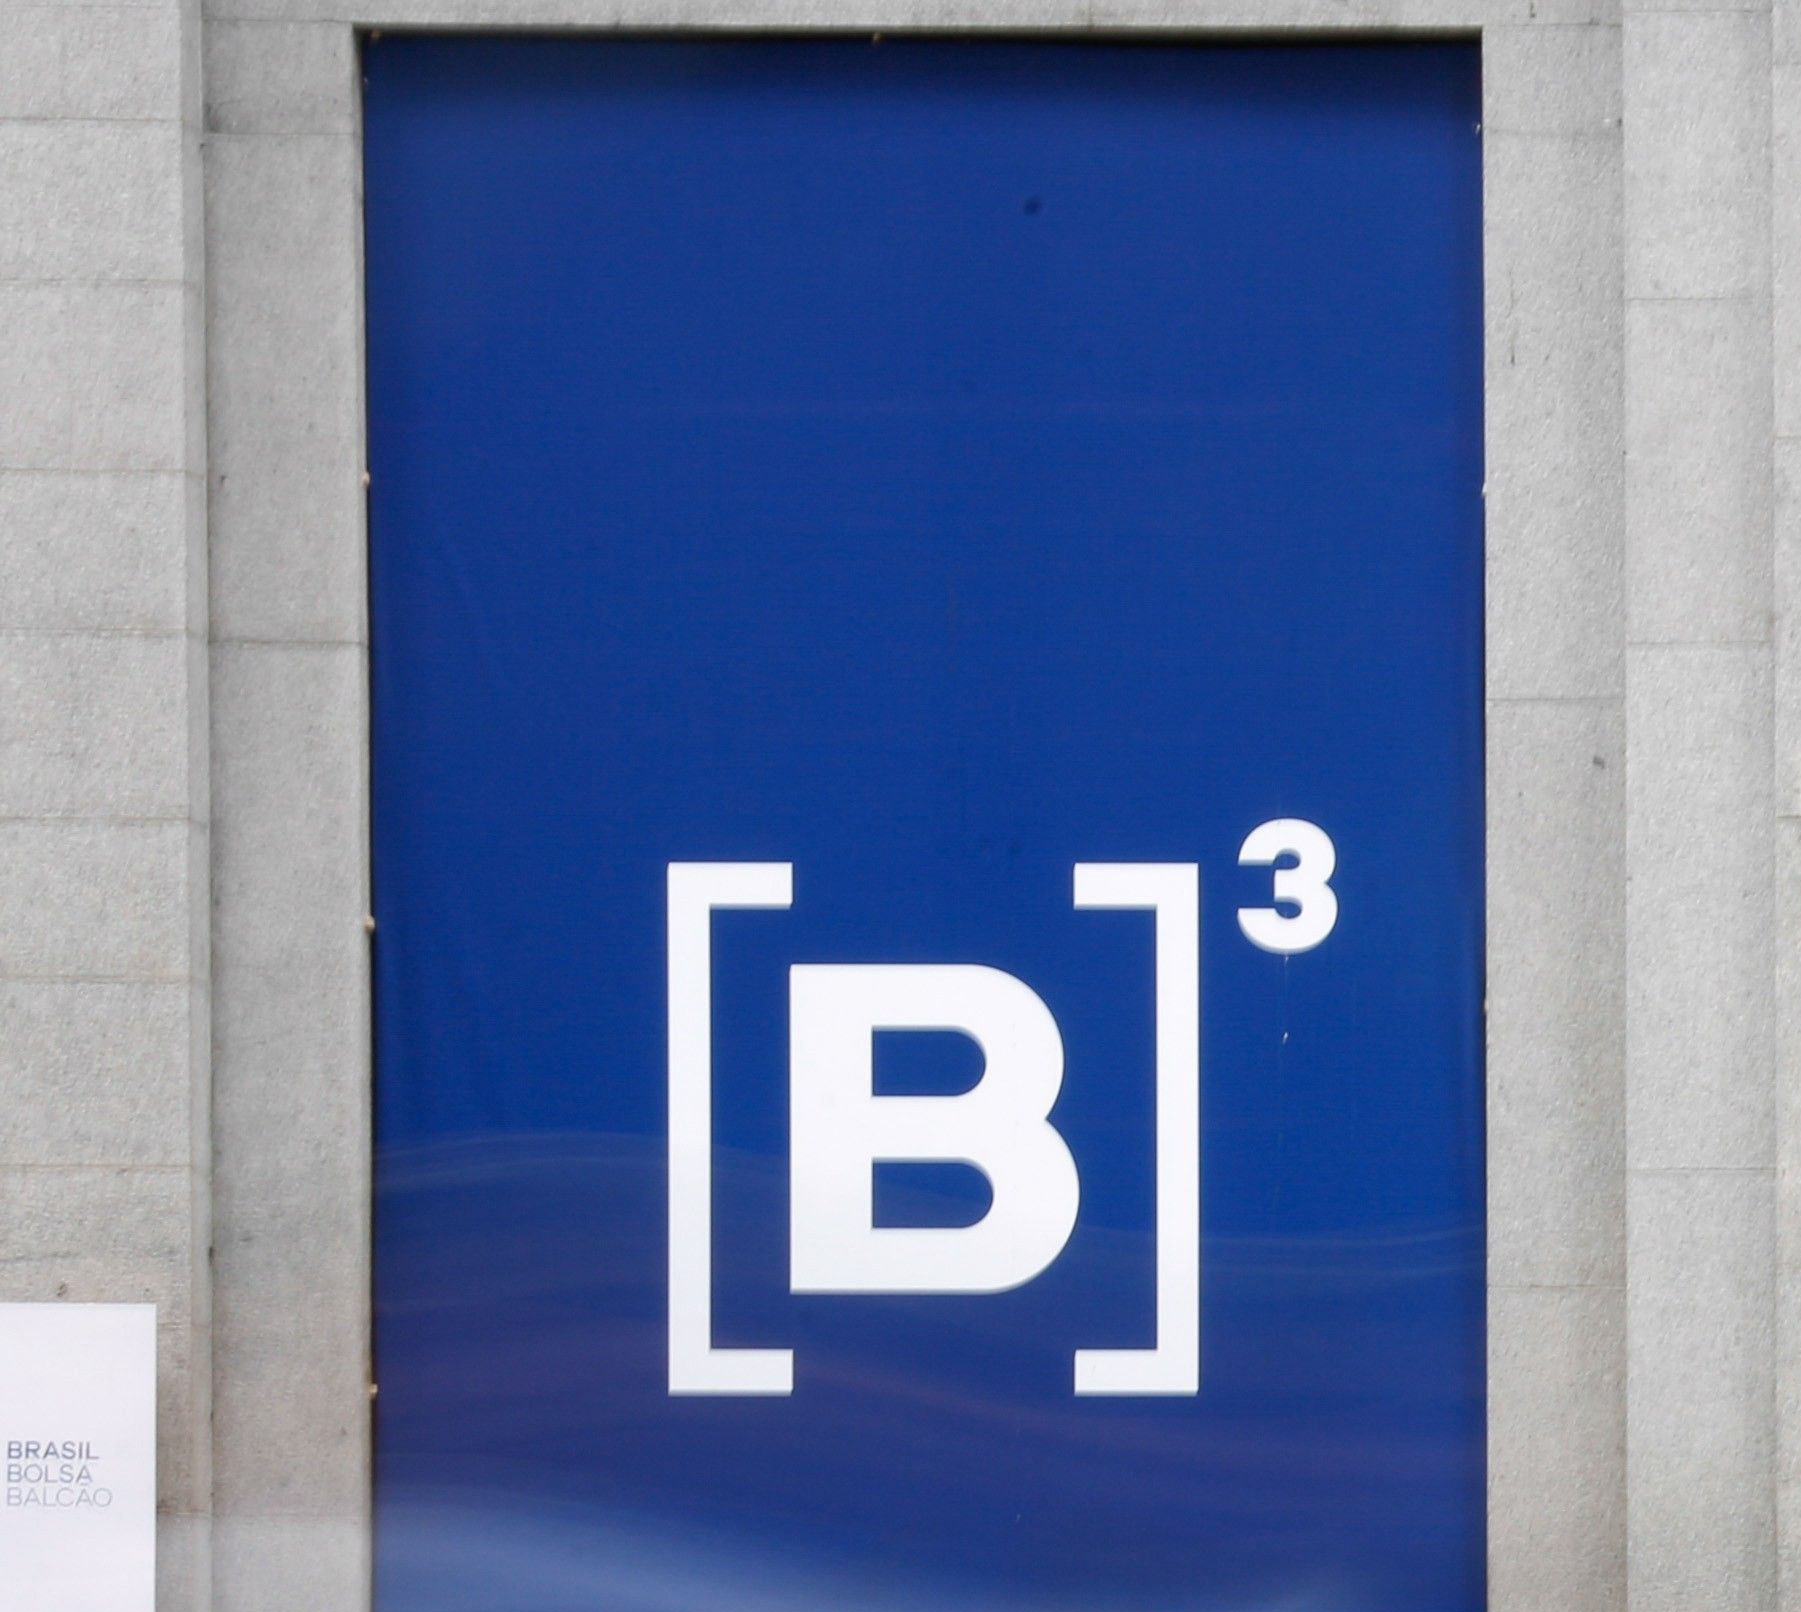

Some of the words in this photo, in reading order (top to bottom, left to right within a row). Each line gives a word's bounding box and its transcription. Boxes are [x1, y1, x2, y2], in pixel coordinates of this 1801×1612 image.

[8, 1441, 99, 1459] BRASIL
[8, 1463, 93, 1482] BOLSA
[8, 1483, 112, 1507] BALCÃO
